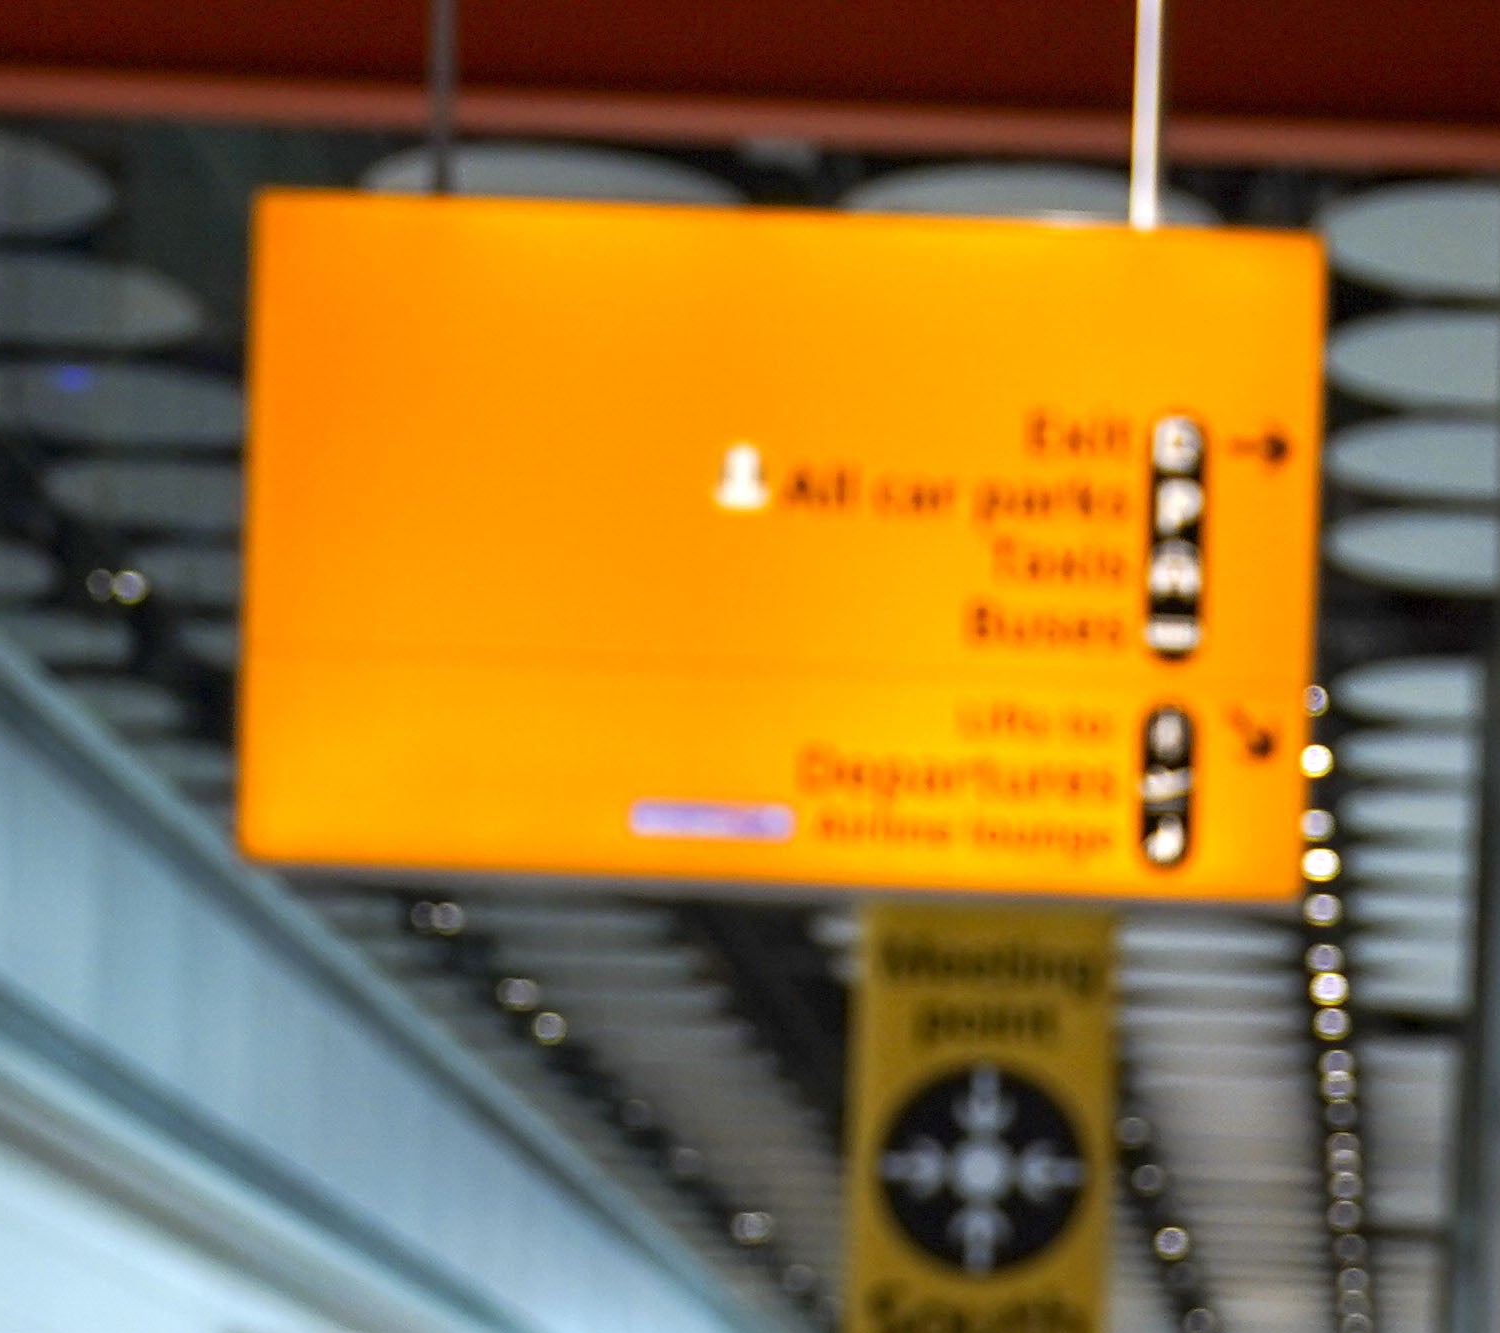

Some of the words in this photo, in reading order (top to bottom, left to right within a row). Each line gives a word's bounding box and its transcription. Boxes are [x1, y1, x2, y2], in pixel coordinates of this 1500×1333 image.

[1024, 410, 1132, 458] Exit
[784, 462, 856, 508] All
[872, 474, 954, 511] car
[970, 474, 1132, 534] parks
[991, 536, 1130, 588] Taxis
[966, 600, 1130, 652] Buses
[798, 743, 1120, 806] Departures
[814, 806, 952, 846] Airline
[881, 935, 1100, 1000] Meeting
[914, 992, 1058, 1046] point
